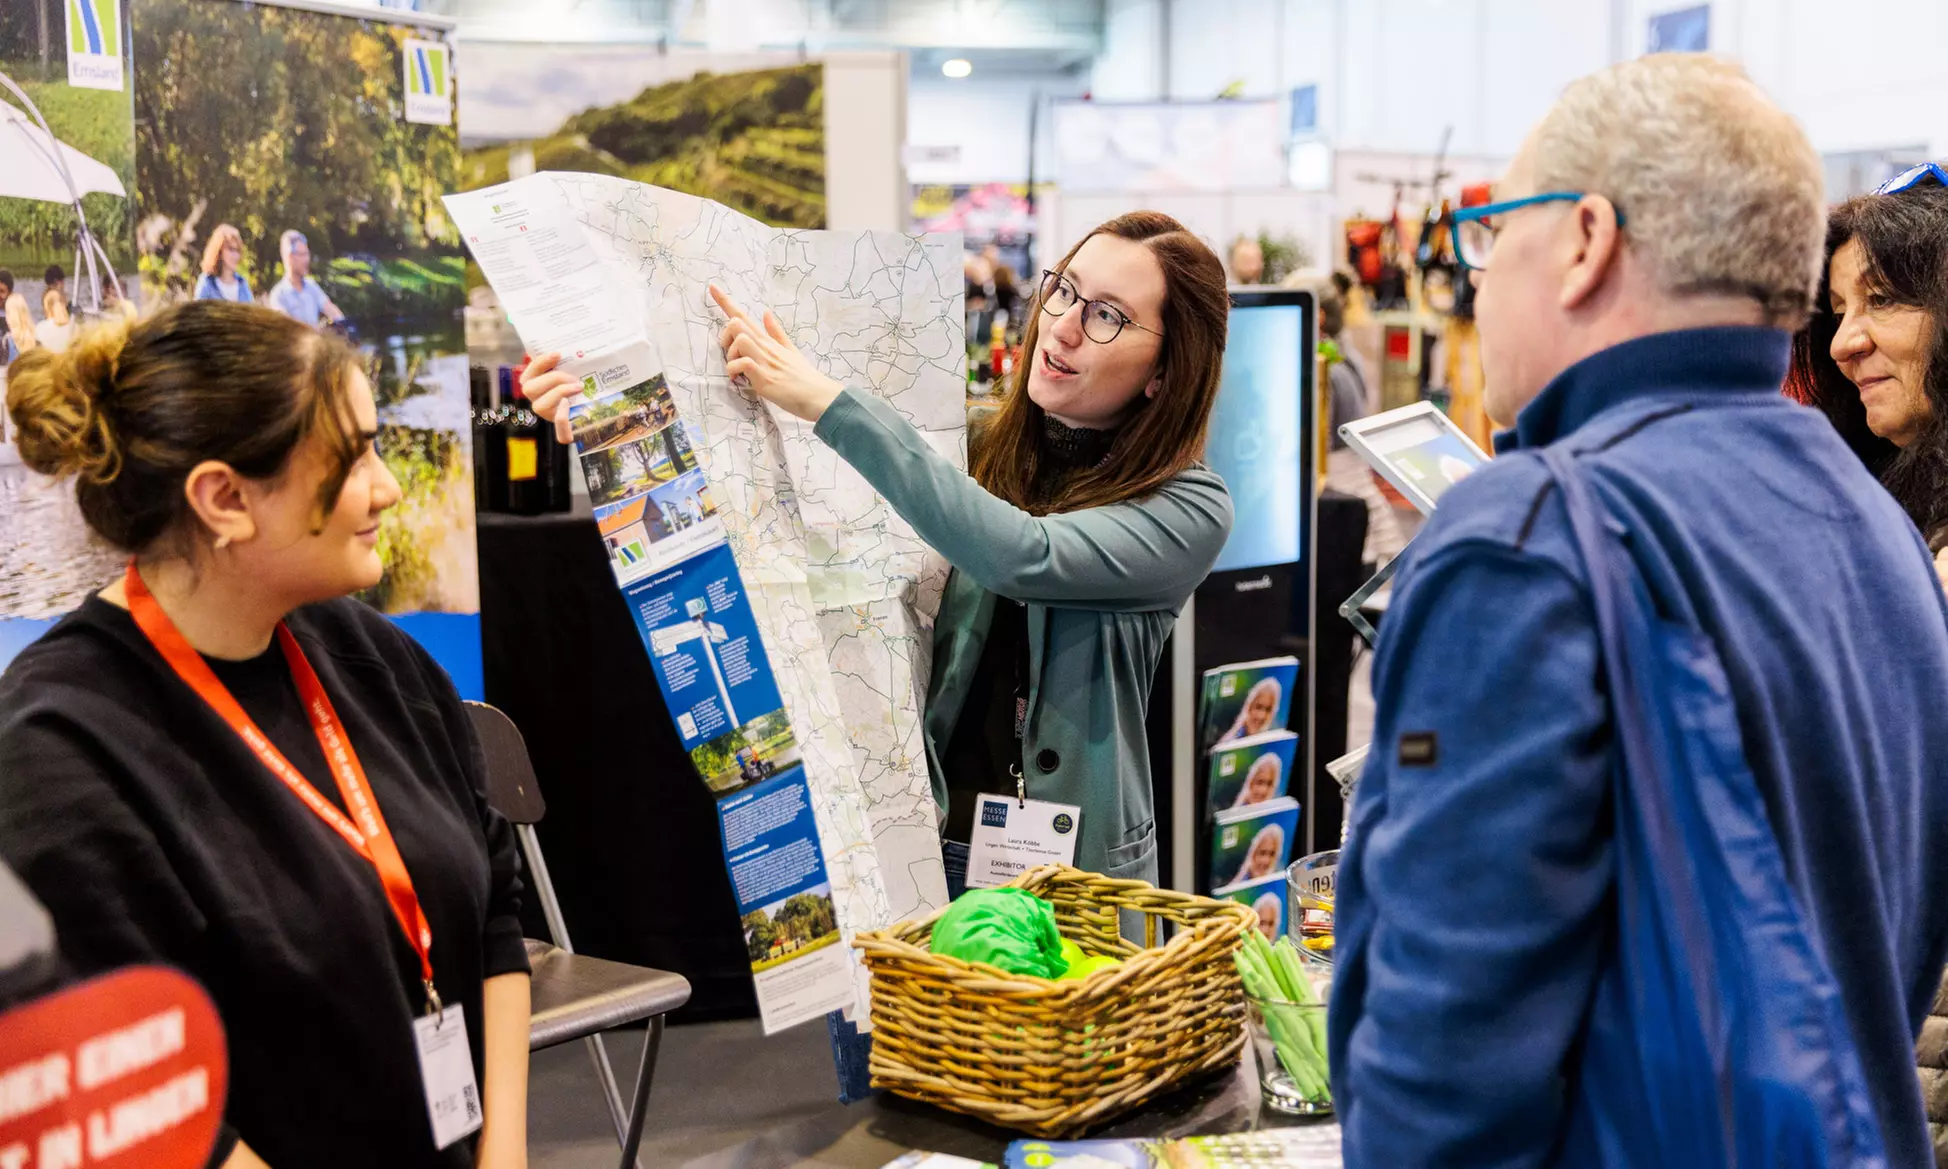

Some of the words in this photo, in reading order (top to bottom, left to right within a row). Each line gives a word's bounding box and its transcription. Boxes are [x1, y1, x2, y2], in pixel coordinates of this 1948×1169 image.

[983, 806, 1006, 815] MESSE
[983, 814, 1005, 823] ESSEN
[991, 860, 1026, 870] EXHIBITOR
